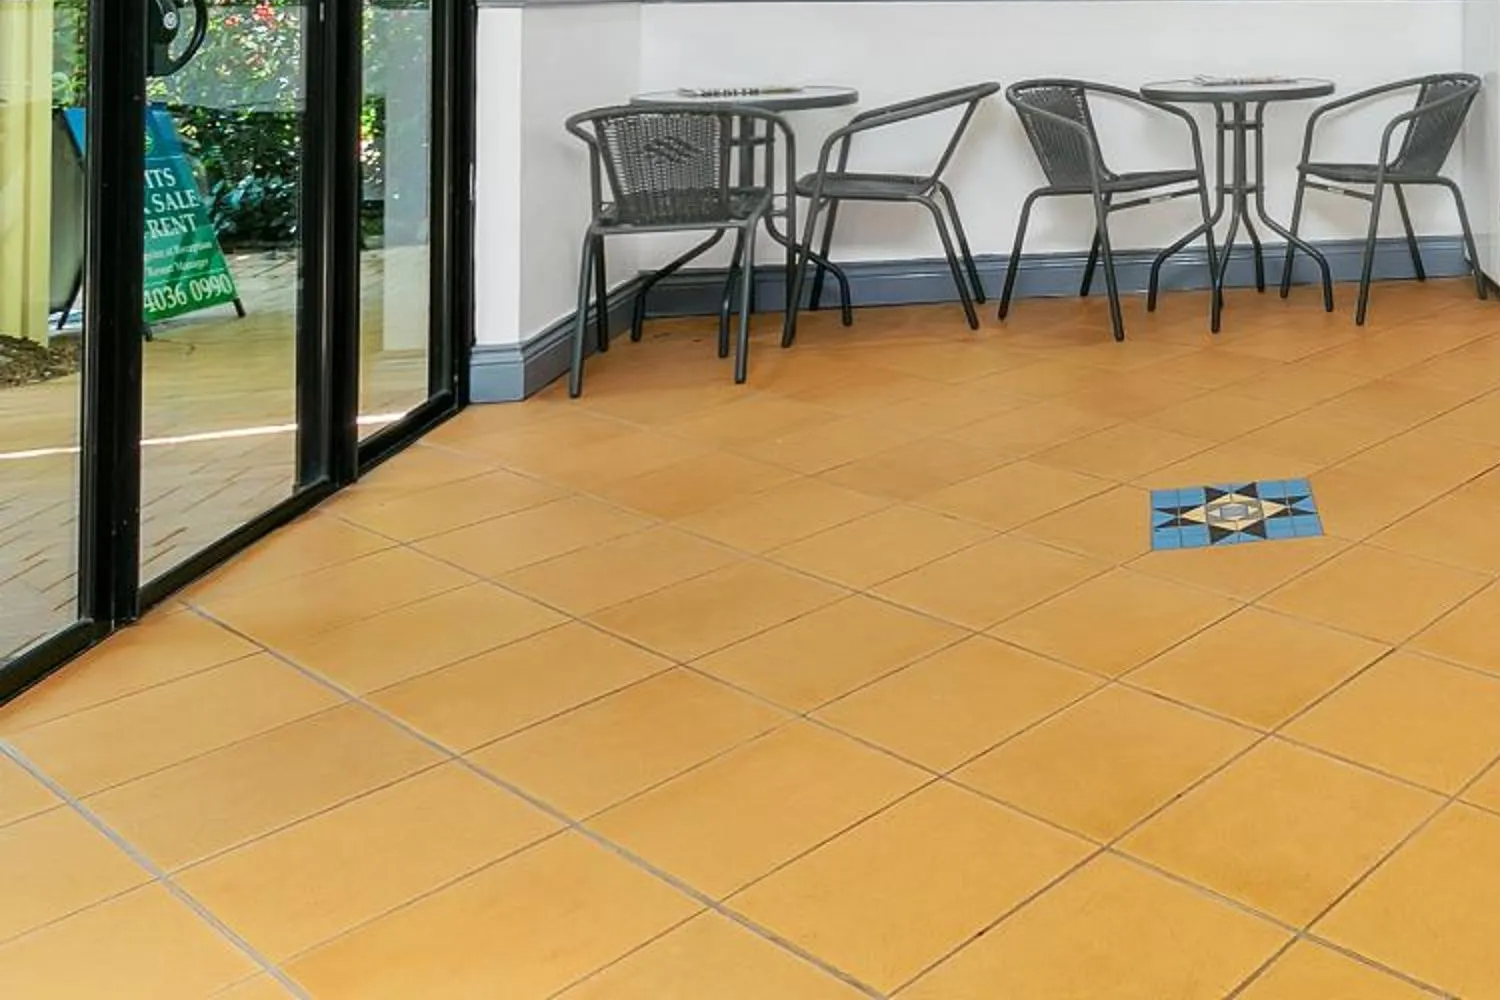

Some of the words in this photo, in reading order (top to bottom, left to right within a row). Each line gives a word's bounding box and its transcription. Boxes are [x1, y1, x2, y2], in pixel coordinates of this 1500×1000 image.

[144, 168, 177, 189] ITS
[151, 189, 201, 213] SALE
[146, 213, 196, 239] RENT
[144, 282, 187, 313] 4036
[189, 272, 233, 302] 0990
